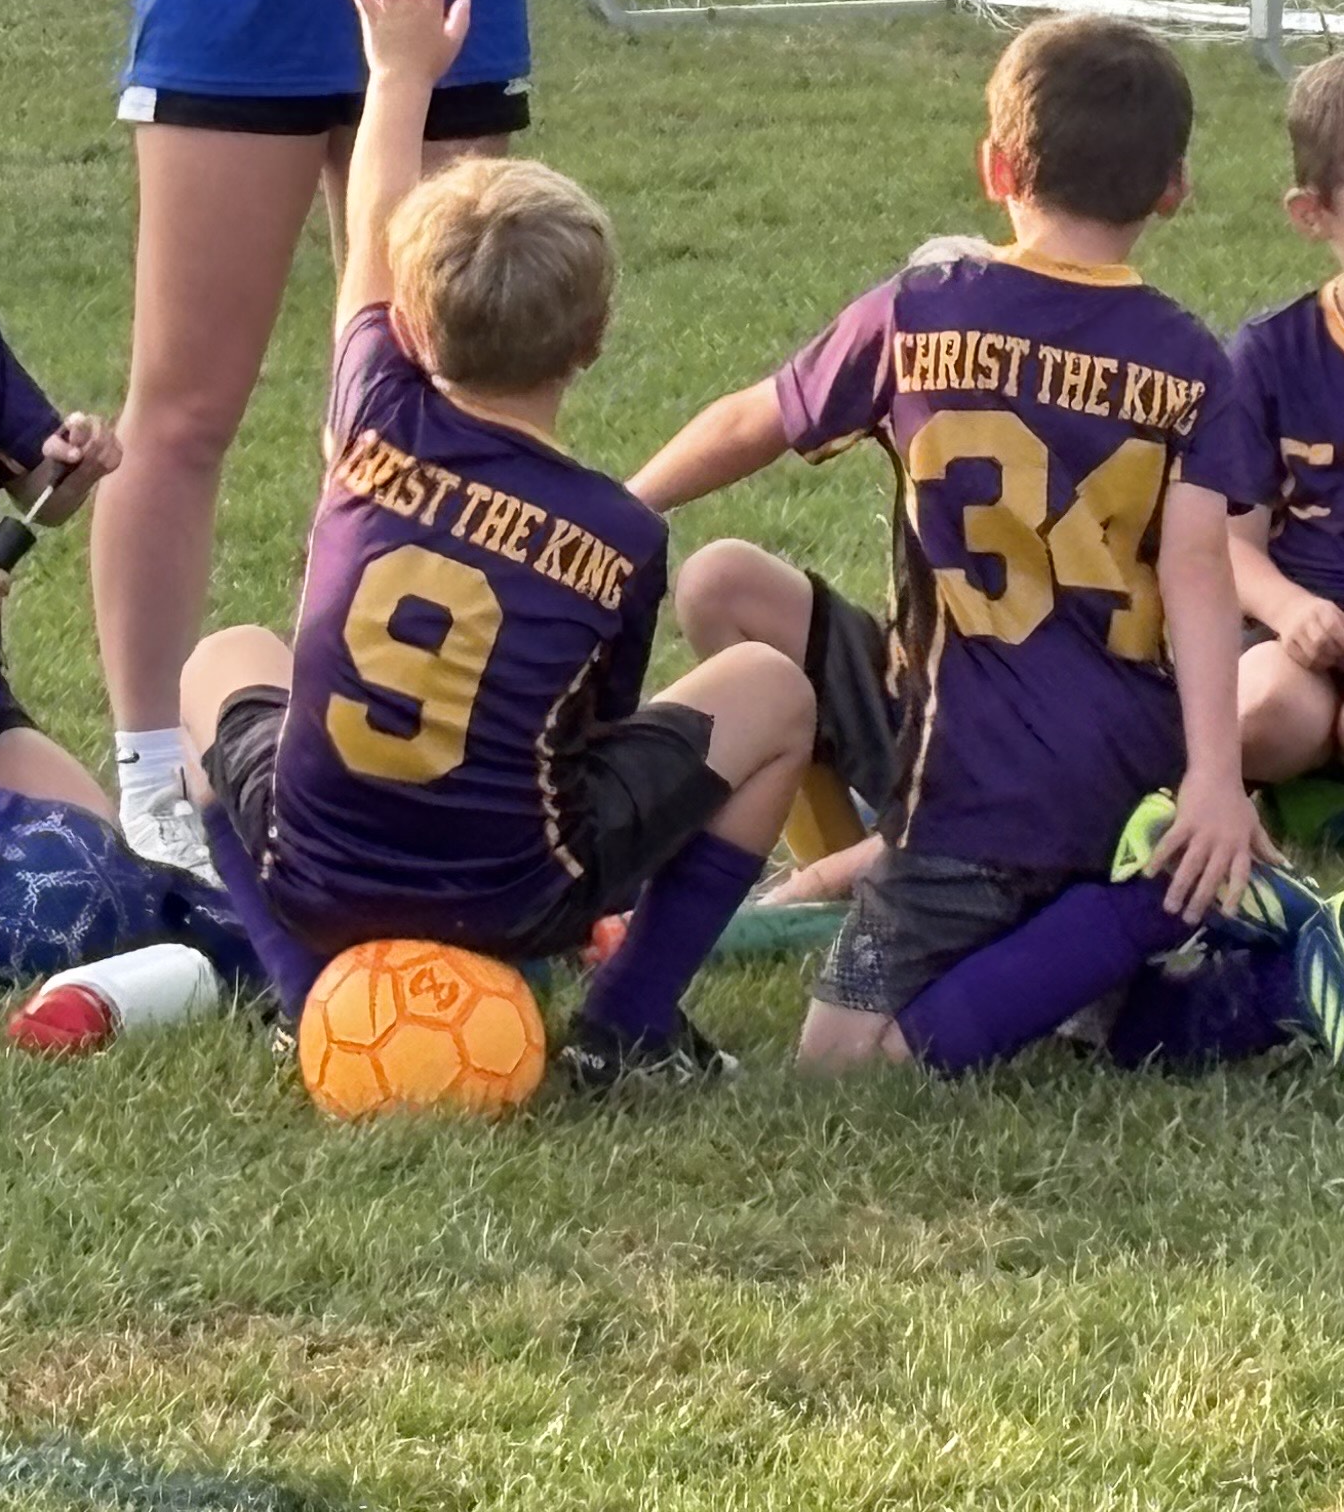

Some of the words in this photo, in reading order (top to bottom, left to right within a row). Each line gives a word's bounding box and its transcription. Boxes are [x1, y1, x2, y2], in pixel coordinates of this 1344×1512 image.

[893, 330, 1030, 397] CHRIST
[1037, 344, 1120, 416] THE
[451, 482, 547, 563] THE
[533, 518, 635, 610] KING
[908, 410, 1167, 662] 34
[326, 544, 503, 785] 9
